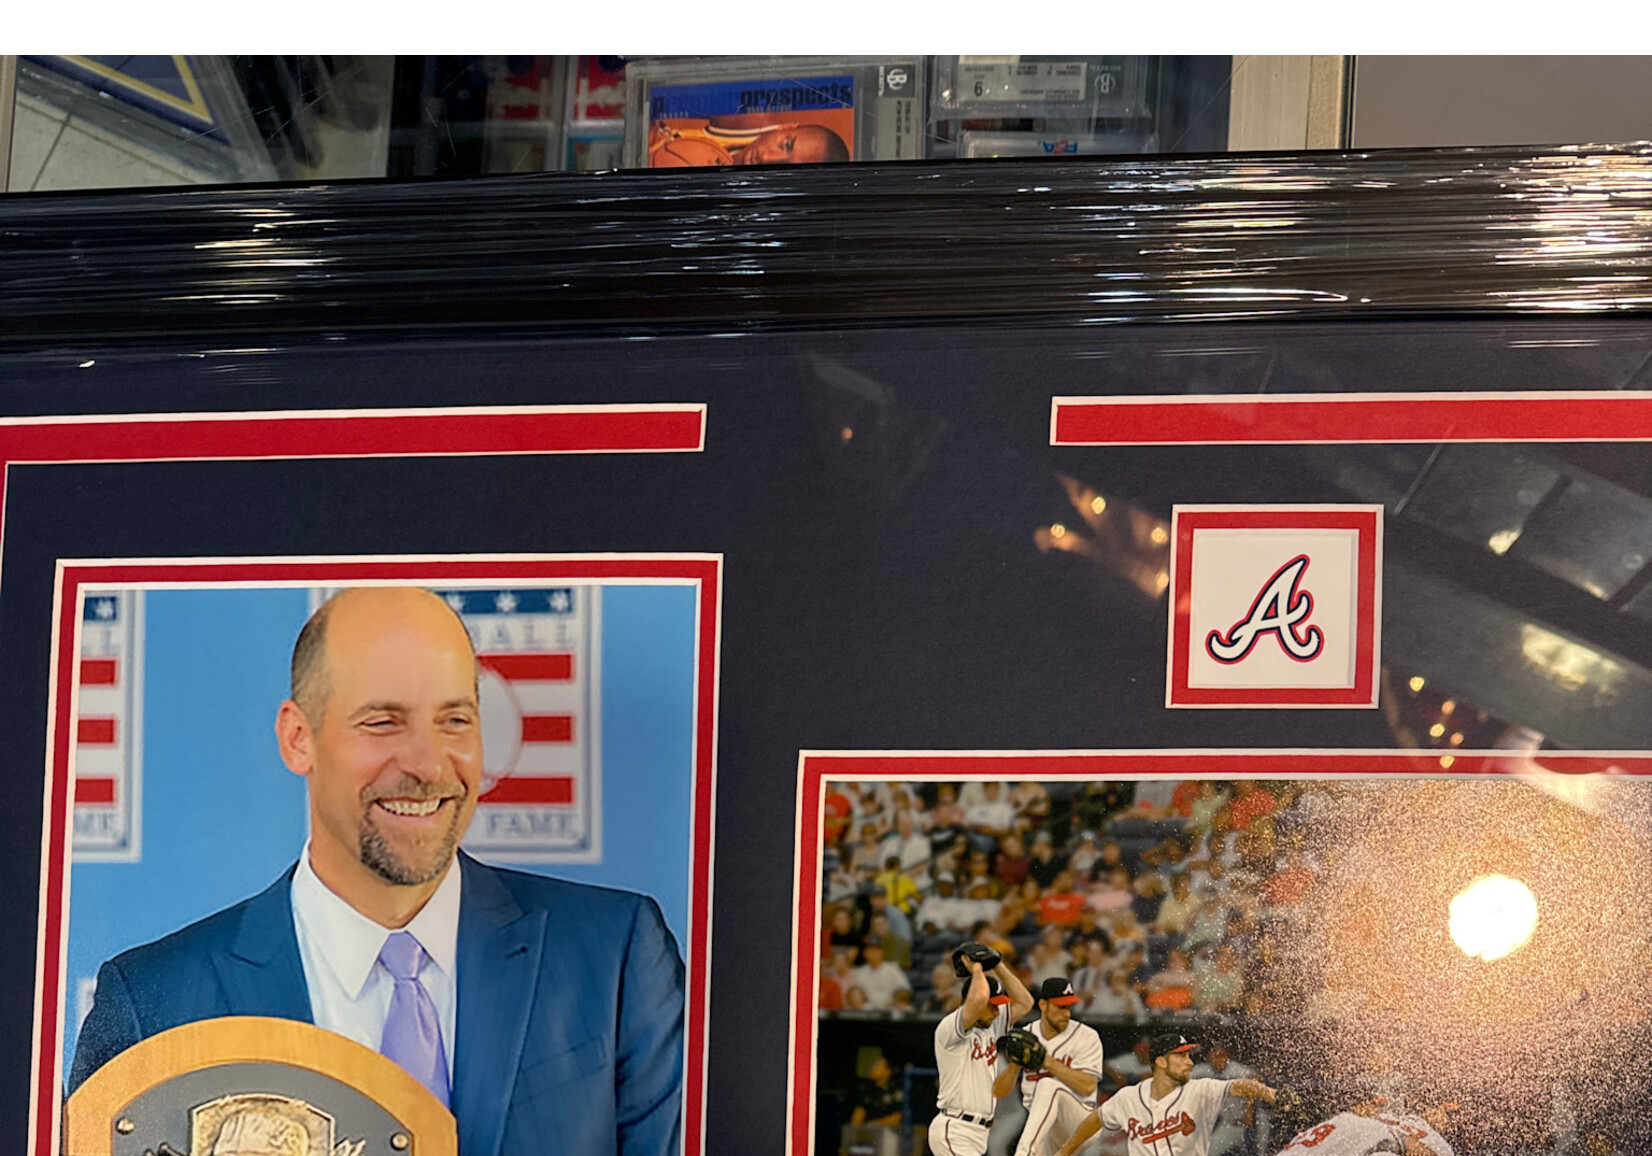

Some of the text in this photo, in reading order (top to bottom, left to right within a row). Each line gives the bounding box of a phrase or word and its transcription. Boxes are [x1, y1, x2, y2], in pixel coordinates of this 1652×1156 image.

[739, 82, 851, 108] prospects
[1205, 554, 1325, 665] A
[1127, 1109, 1182, 1142] Braves
